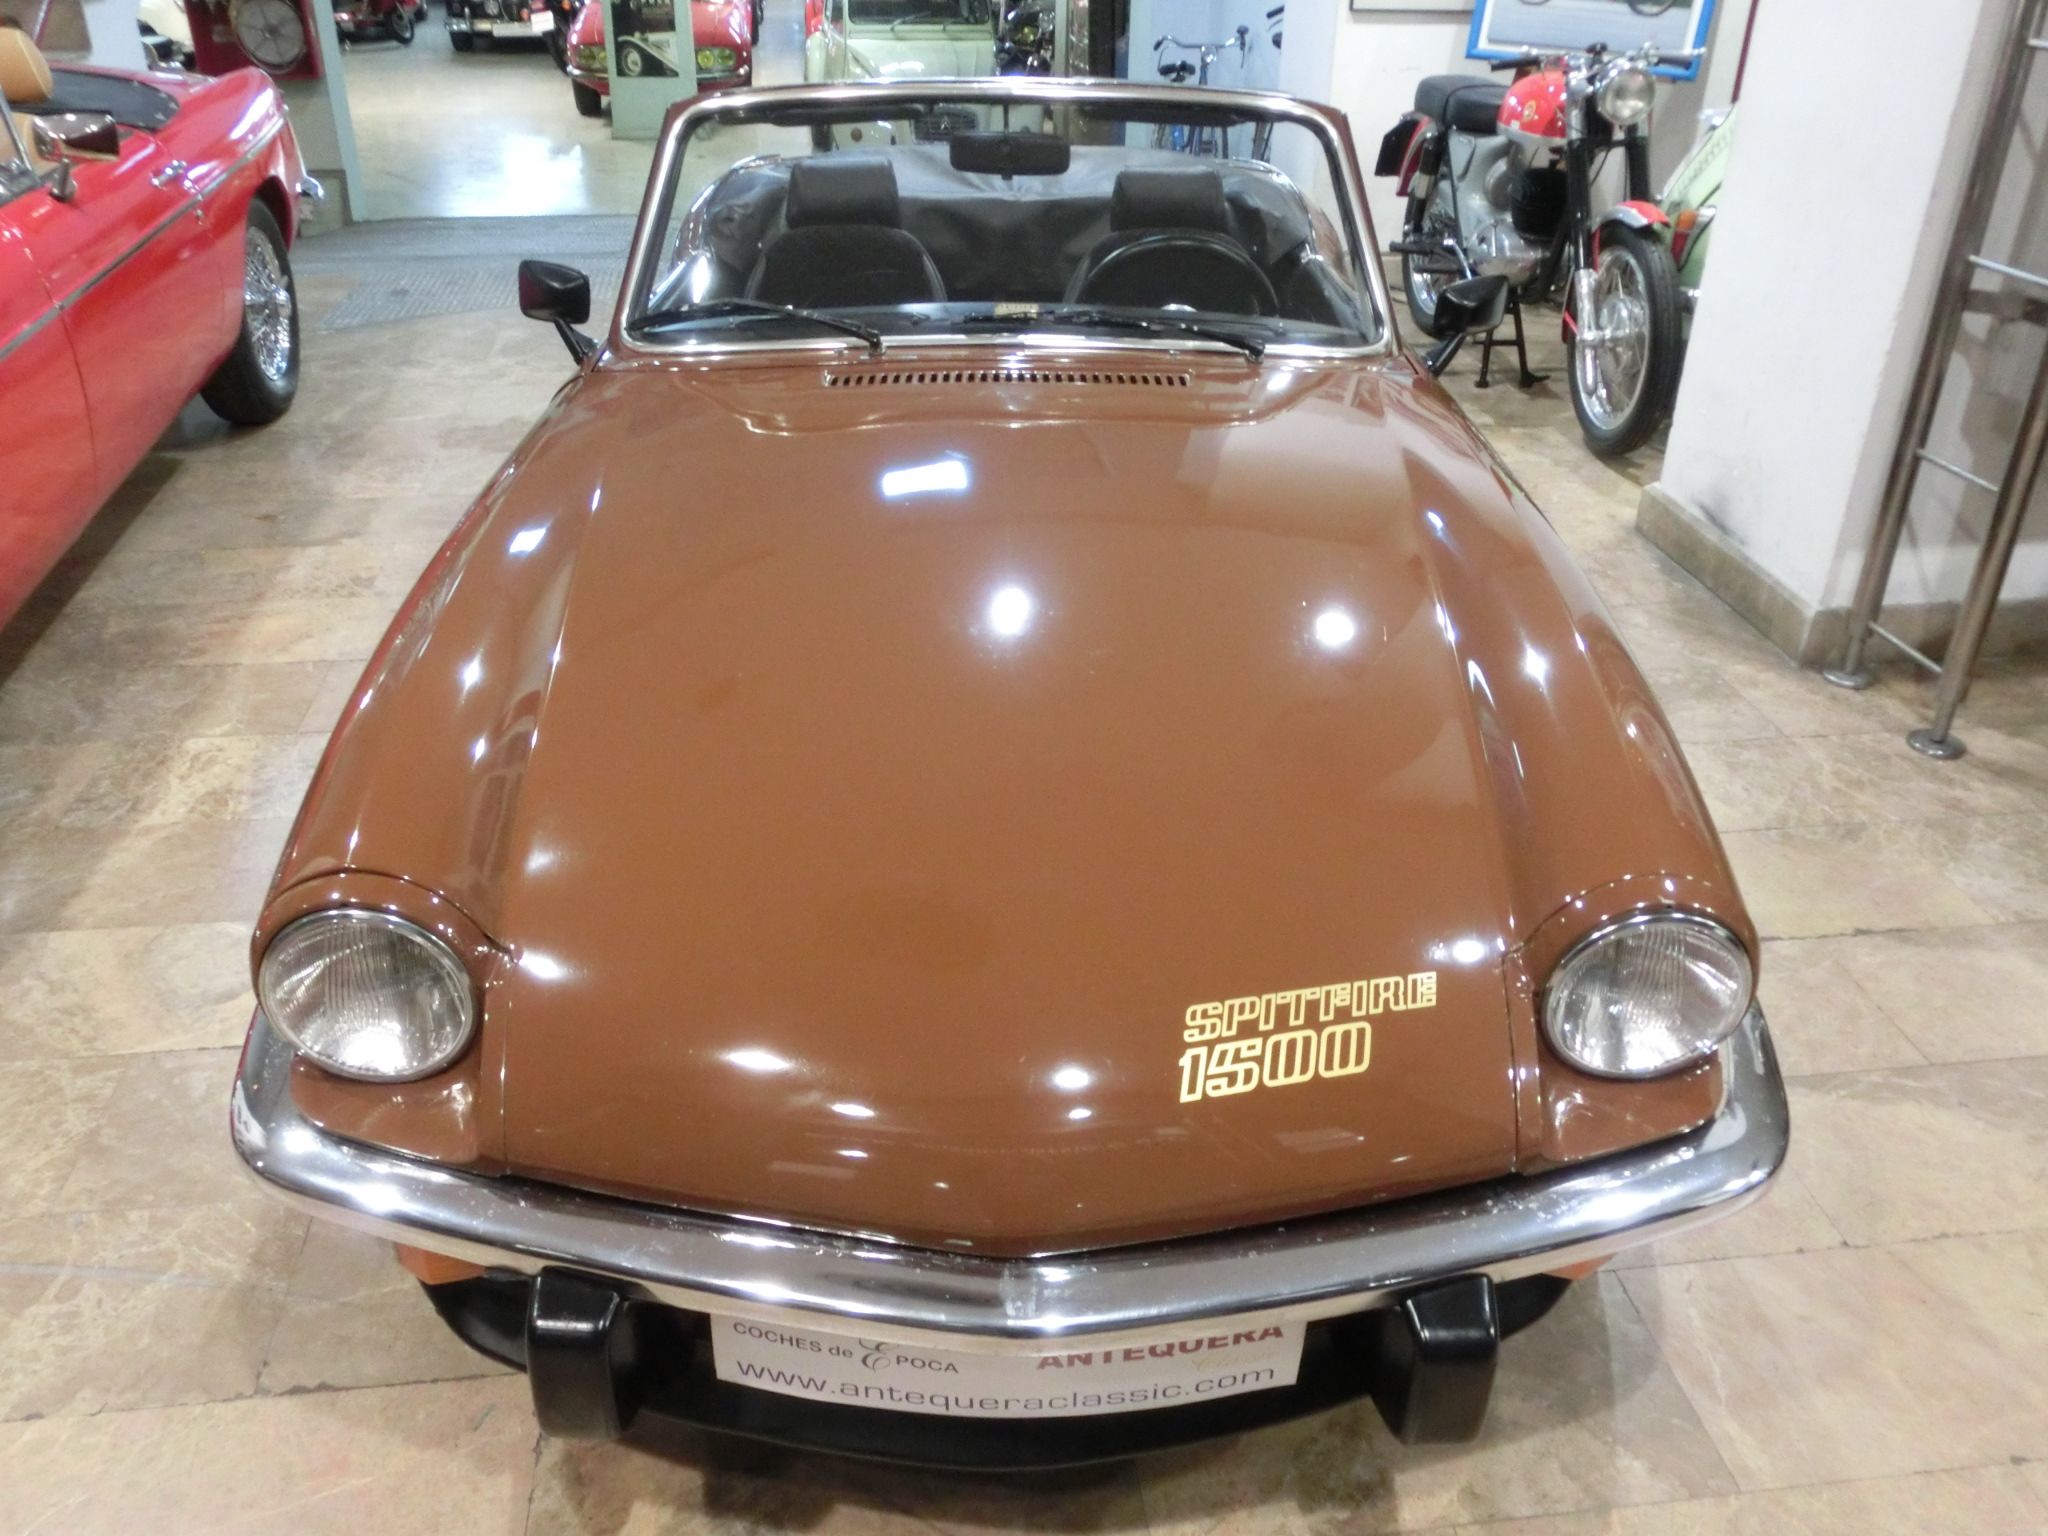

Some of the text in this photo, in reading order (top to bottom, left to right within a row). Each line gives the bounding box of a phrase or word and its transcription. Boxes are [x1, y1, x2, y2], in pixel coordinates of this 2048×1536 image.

[1183, 971, 1437, 1042] SPITFIRE
[1178, 1021, 1372, 1103] 1500
[733, 1321, 822, 1352] COCHES
[828, 1345, 853, 1359] de
[1037, 1326, 1284, 1370] ANTEQUERA
[737, 1360, 1274, 1414] www.antequeraclassic.com
